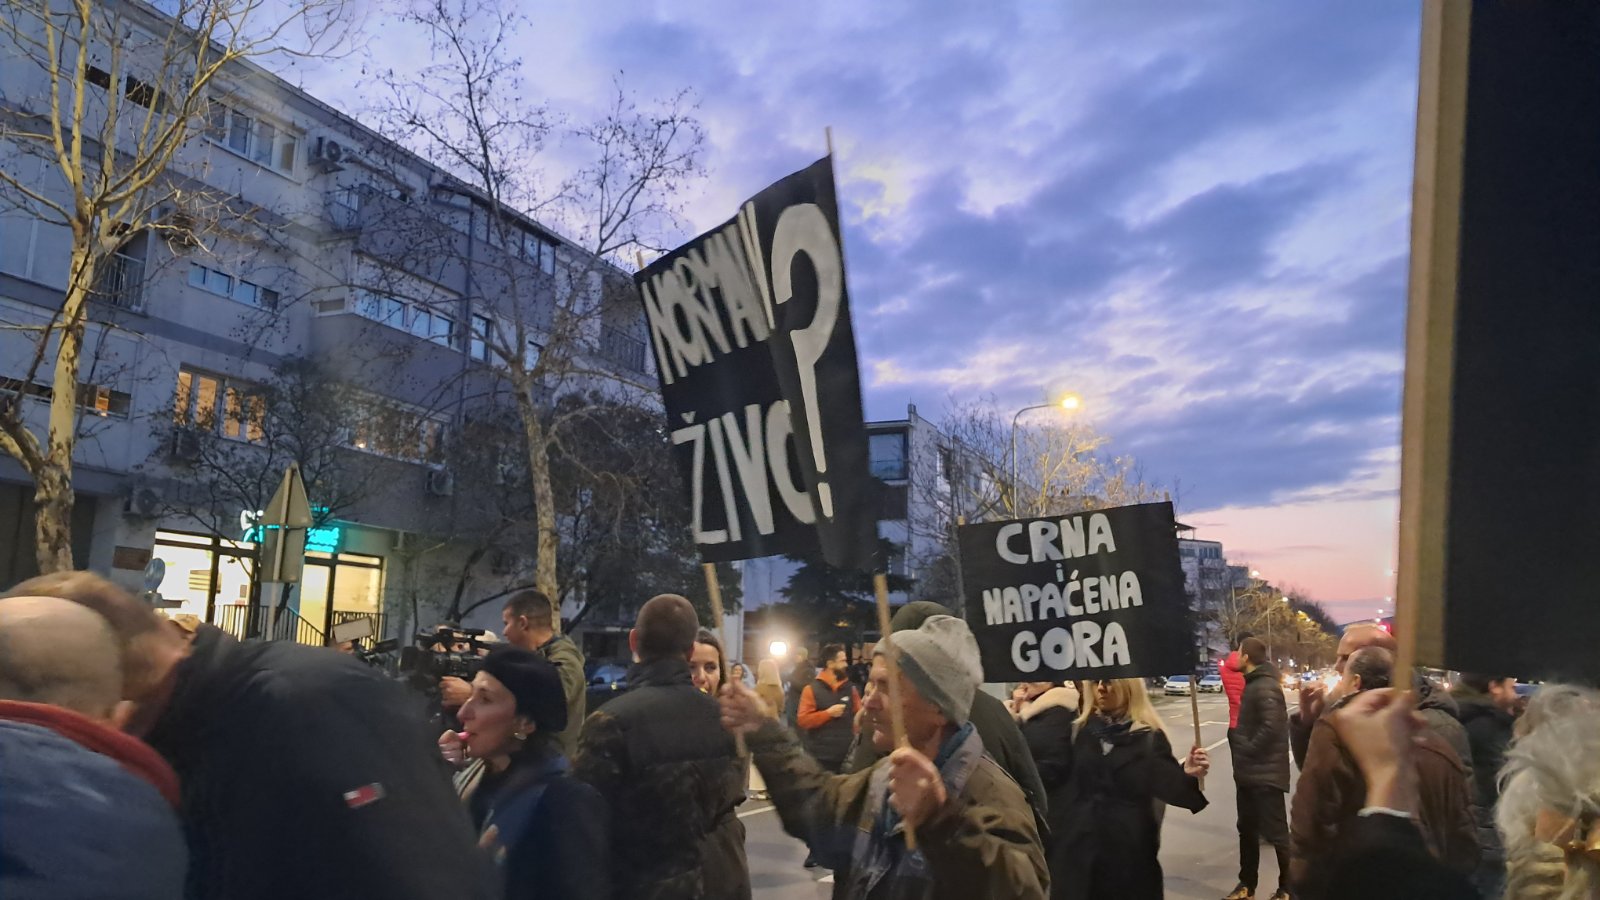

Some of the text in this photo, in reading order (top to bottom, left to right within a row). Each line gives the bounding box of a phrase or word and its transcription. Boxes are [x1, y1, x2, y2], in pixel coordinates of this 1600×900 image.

[996, 513, 1116, 565] CRNA
[982, 569, 1144, 626] NAPAĆENA
[1055, 563, 1064, 583] i
[1011, 620, 1131, 673] GORA
